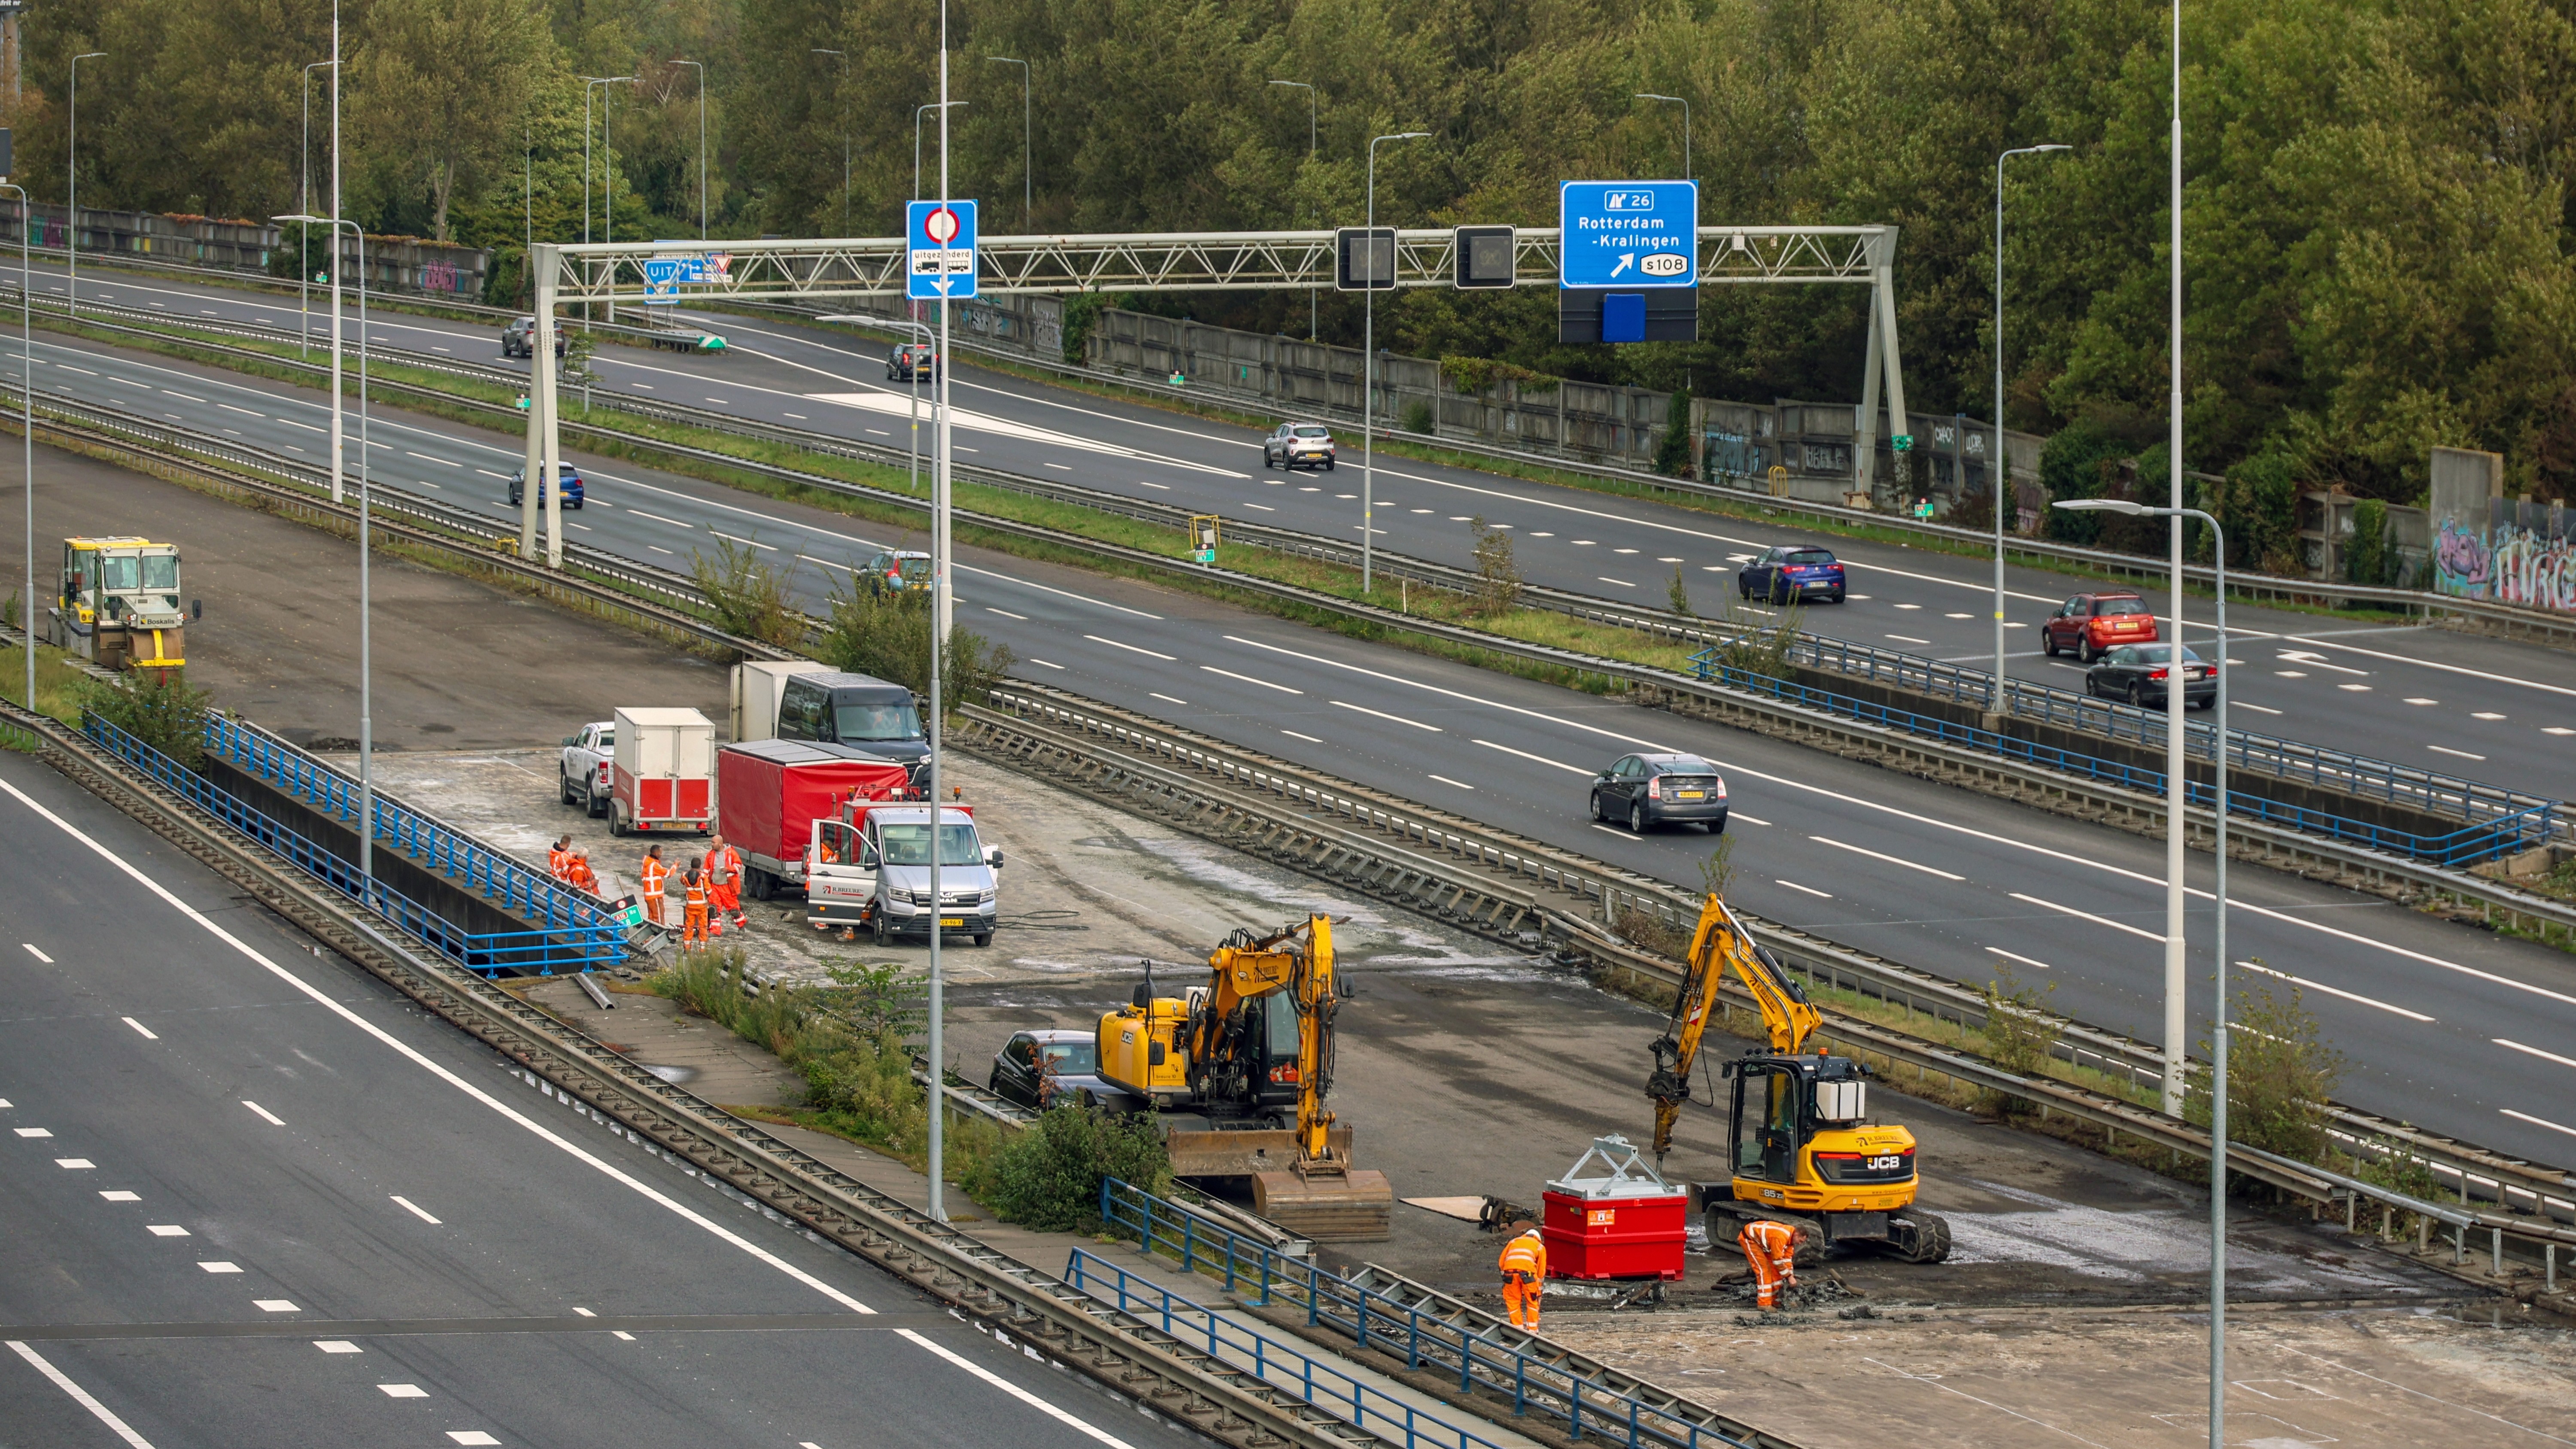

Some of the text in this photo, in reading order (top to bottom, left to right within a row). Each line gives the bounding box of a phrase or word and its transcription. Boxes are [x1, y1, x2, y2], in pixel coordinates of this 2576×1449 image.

[1631, 195, 1649, 206] 26
[1579, 217, 1664, 229] Rotterdam
[1592, 234, 1679, 249] -Kralingen
[915, 251, 969, 260] uitgeznderd
[650, 267, 672, 276] UIT
[616, 913, 626, 921] A16
[1121, 1031, 1133, 1044] JCB
[1867, 1156, 1899, 1169] JCB
[1736, 1185, 1742, 1194] 42
